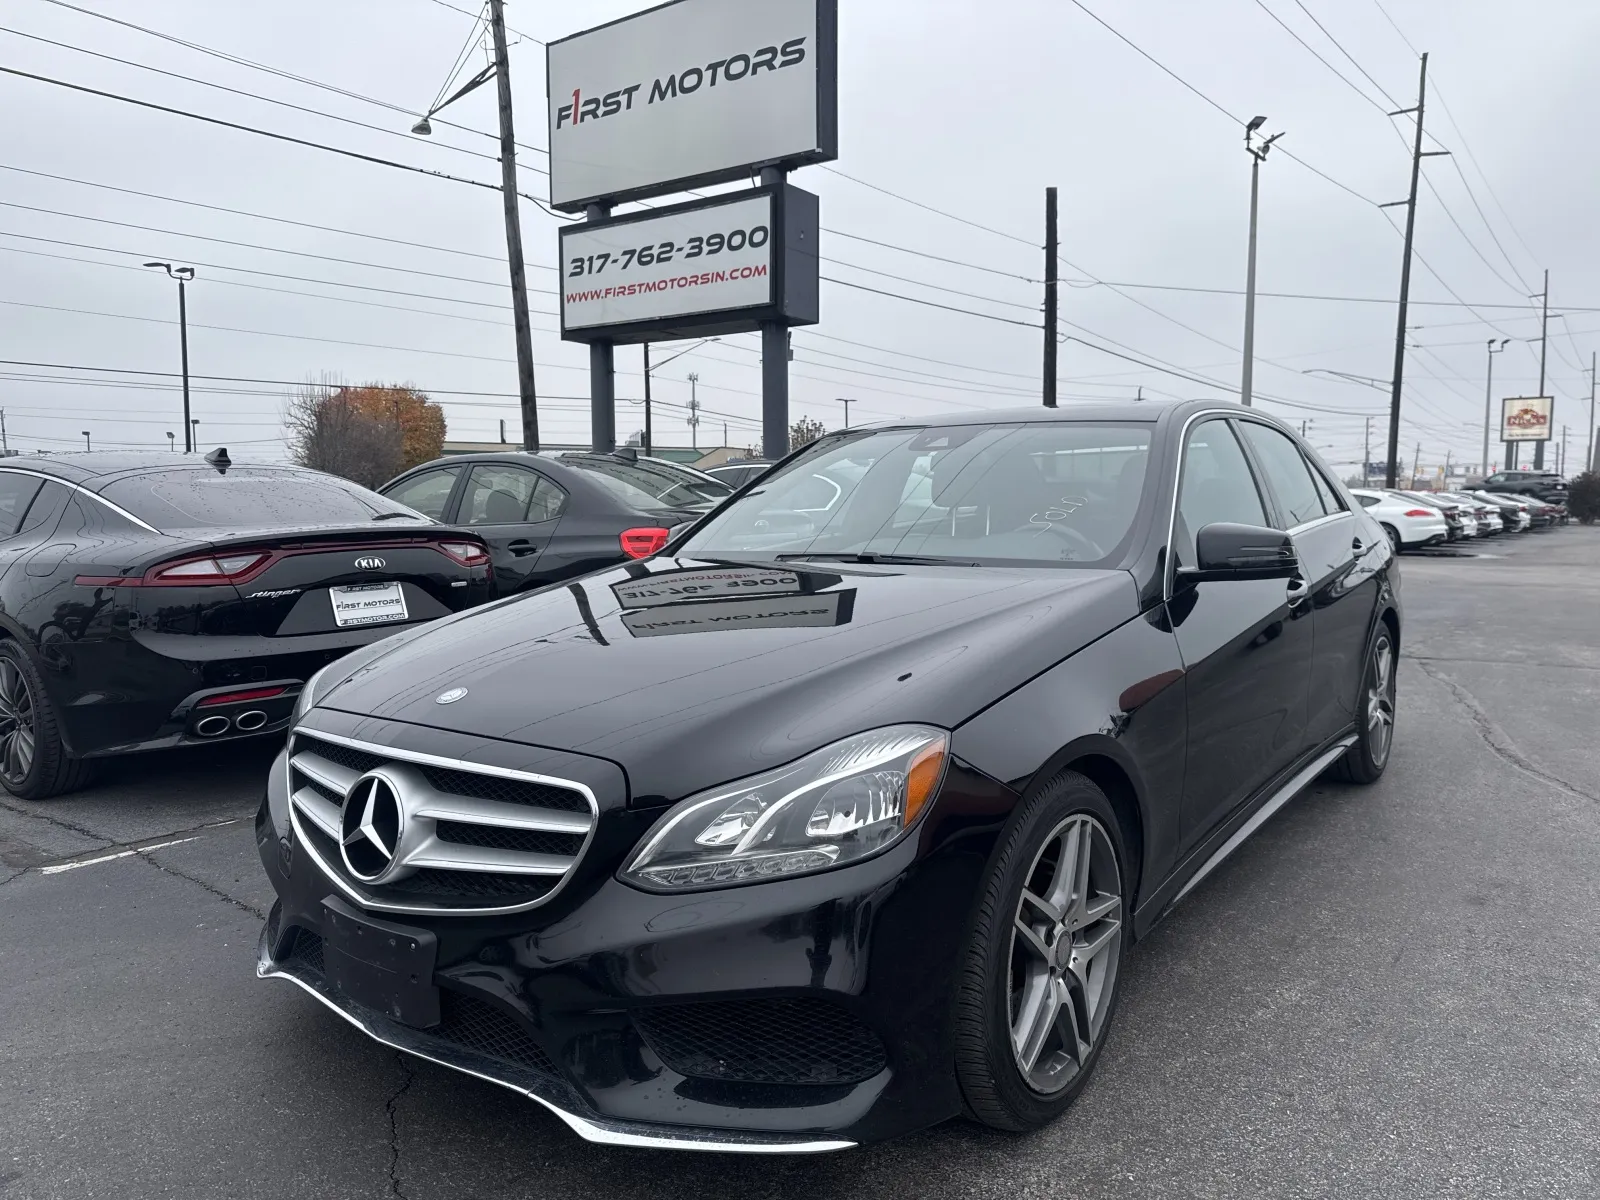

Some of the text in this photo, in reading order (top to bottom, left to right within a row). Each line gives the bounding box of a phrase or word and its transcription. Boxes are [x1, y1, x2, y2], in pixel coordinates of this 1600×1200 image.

[648, 37, 807, 104] MOTORS
[568, 225, 769, 278] 317-762-3900
[566, 264, 767, 304] WWW.FIRSTMOTORSIN.COM
[1029, 495, 1089, 538] SOLD
[360, 558, 382, 569] KIA
[363, 598, 401, 607] MOTORS
